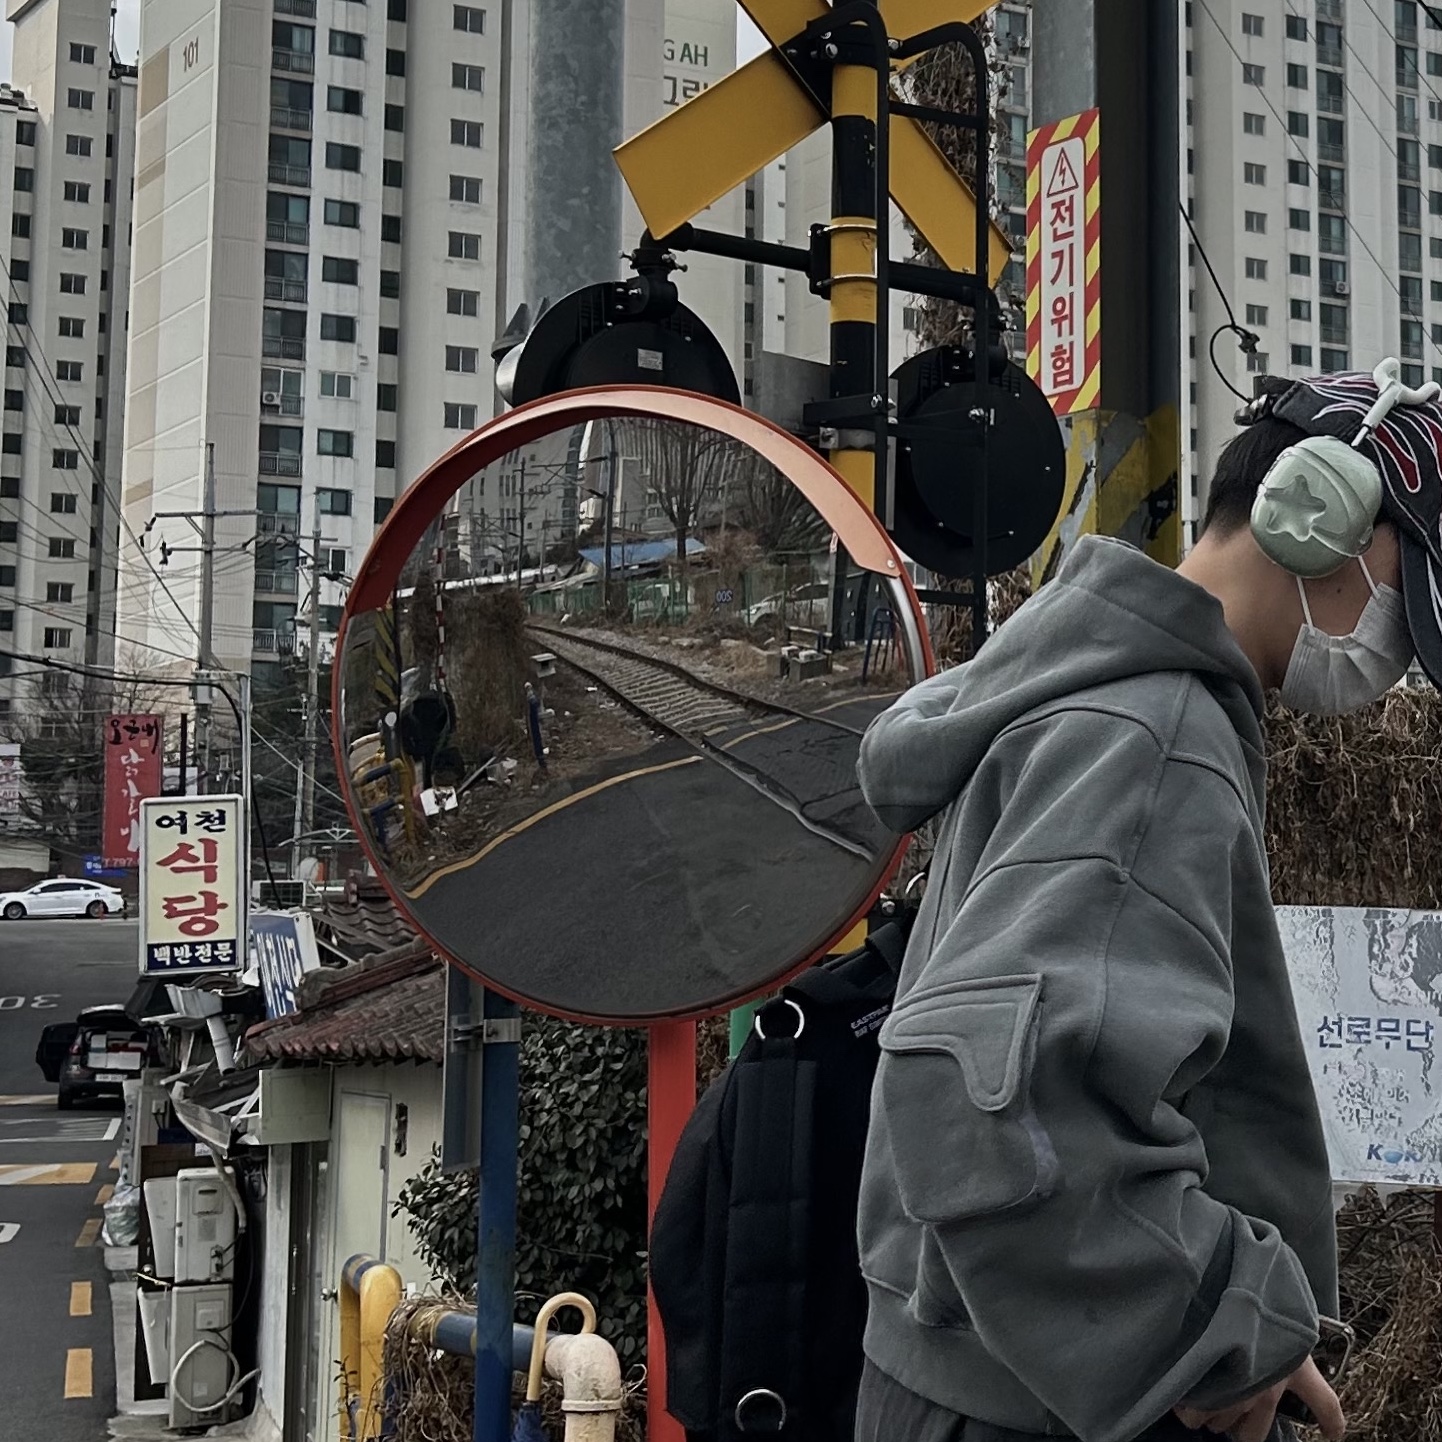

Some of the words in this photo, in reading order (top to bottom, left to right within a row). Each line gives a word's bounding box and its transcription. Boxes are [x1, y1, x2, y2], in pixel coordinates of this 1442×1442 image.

[183, 36, 199, 73] 101
[1049, 195, 1075, 389] 전기위험
[155, 809, 227, 835] 여천
[155, 838, 229, 936] 식당
[153, 943, 233, 966] 백반전문
[1317, 1016, 1434, 1052] 선로무단
